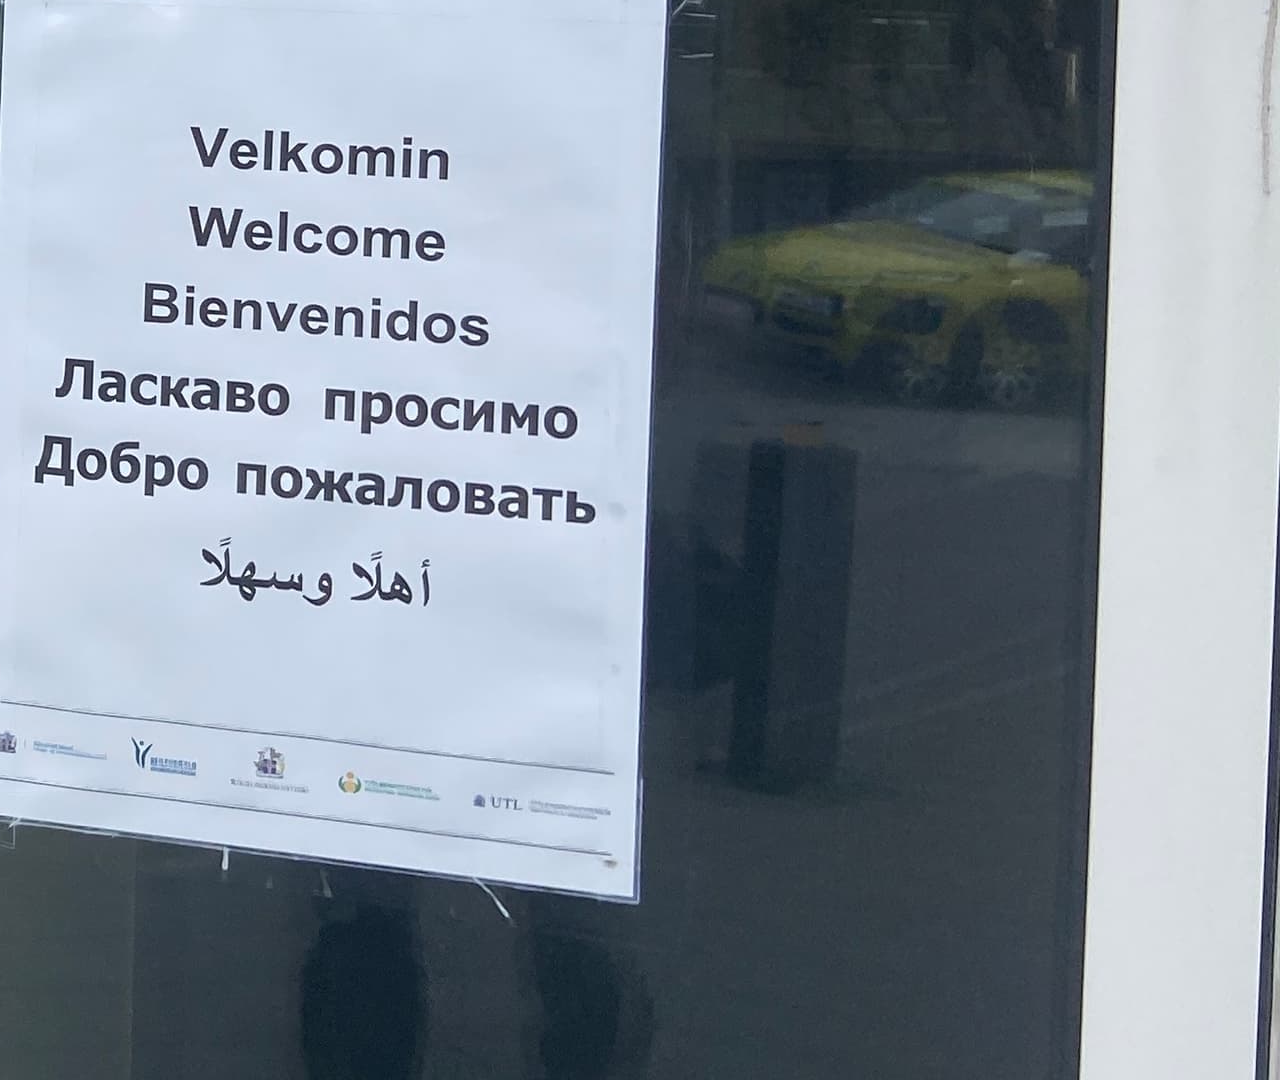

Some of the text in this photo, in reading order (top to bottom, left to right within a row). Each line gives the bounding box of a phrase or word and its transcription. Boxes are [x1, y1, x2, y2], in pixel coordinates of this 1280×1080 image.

[190, 125, 451, 181] Velkomin
[188, 206, 447, 262] Welcome
[143, 281, 491, 347] Bienvenidos
[54, 357, 579, 439] Ласкаво просимо
[33, 434, 598, 525] Добро пожаловать
[490, 796, 524, 811] UTL
